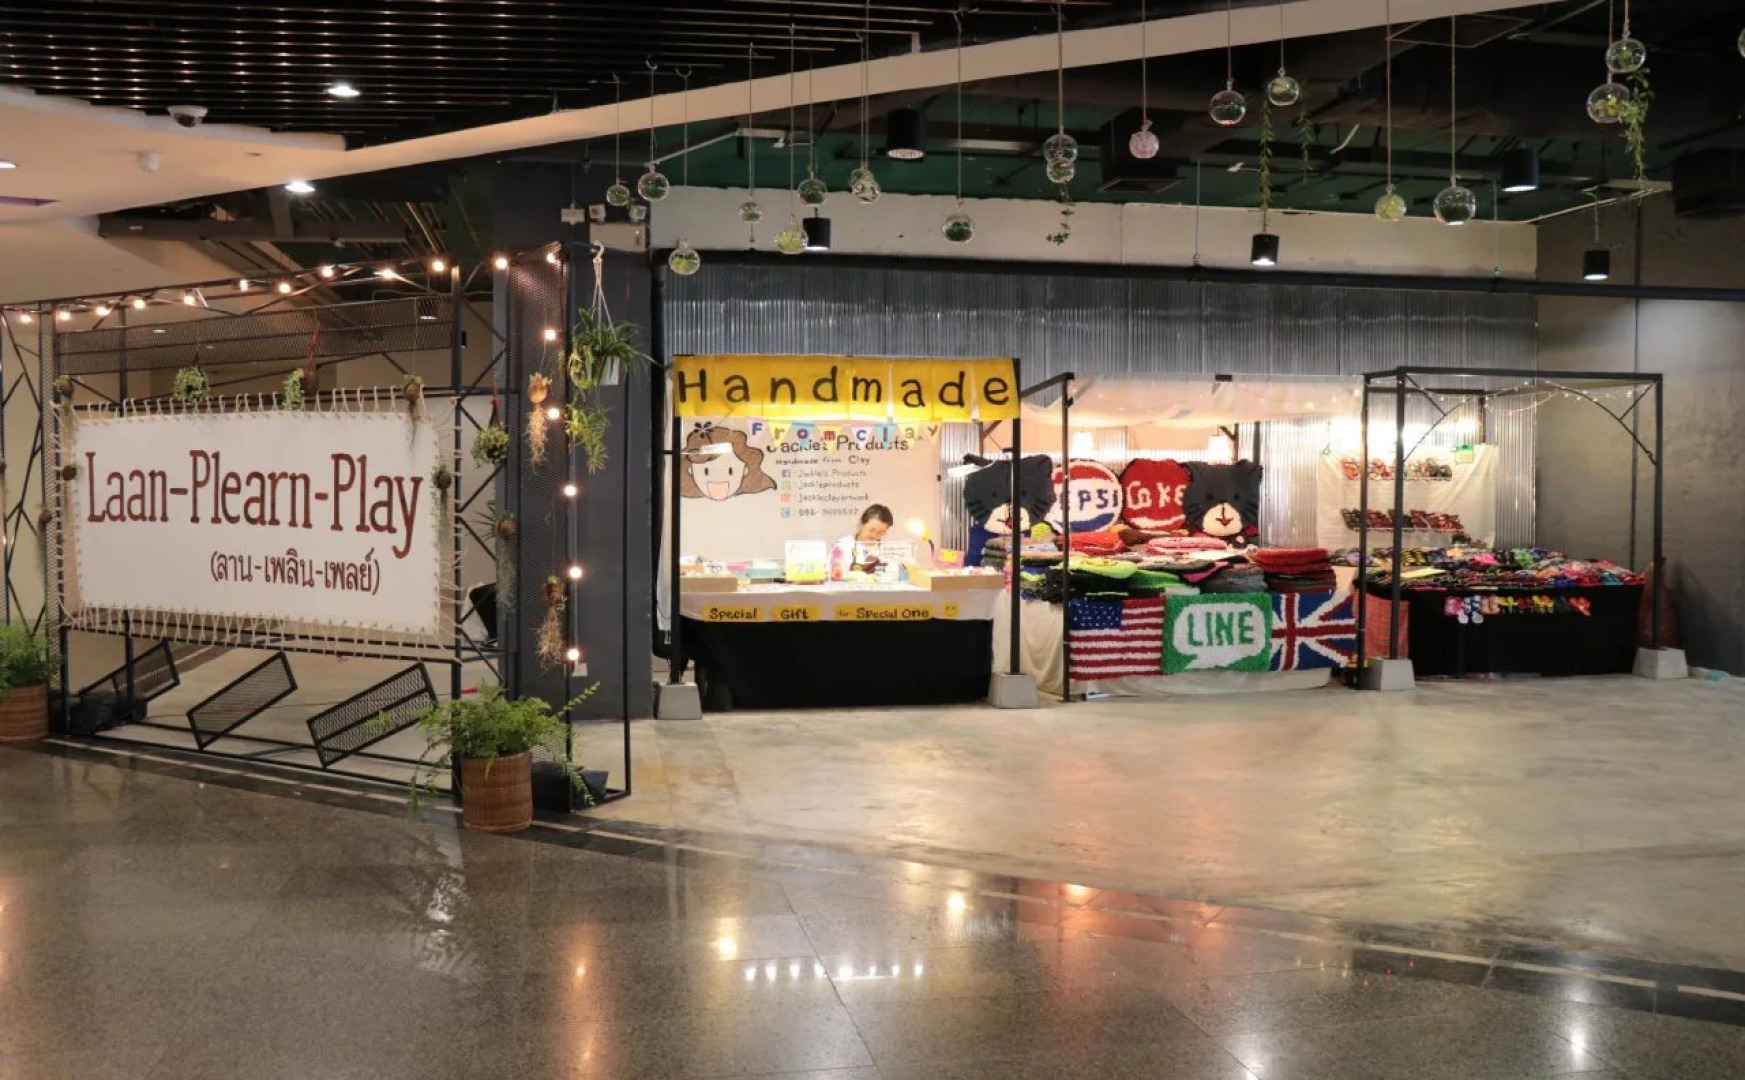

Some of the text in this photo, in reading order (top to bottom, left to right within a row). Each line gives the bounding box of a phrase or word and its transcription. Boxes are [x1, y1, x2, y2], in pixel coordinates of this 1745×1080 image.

[678, 365, 1009, 408] Handmade
[848, 455, 871, 466] Clay
[84, 449, 424, 559] Laan-Plearn-Play
[1060, 488, 1119, 511] PSI
[210, 546, 381, 596] (ลาน-เพลิน-เพลย์)
[708, 606, 758, 620] Special
[779, 607, 810, 620] Gift
[1187, 610, 1255, 648] LINE
